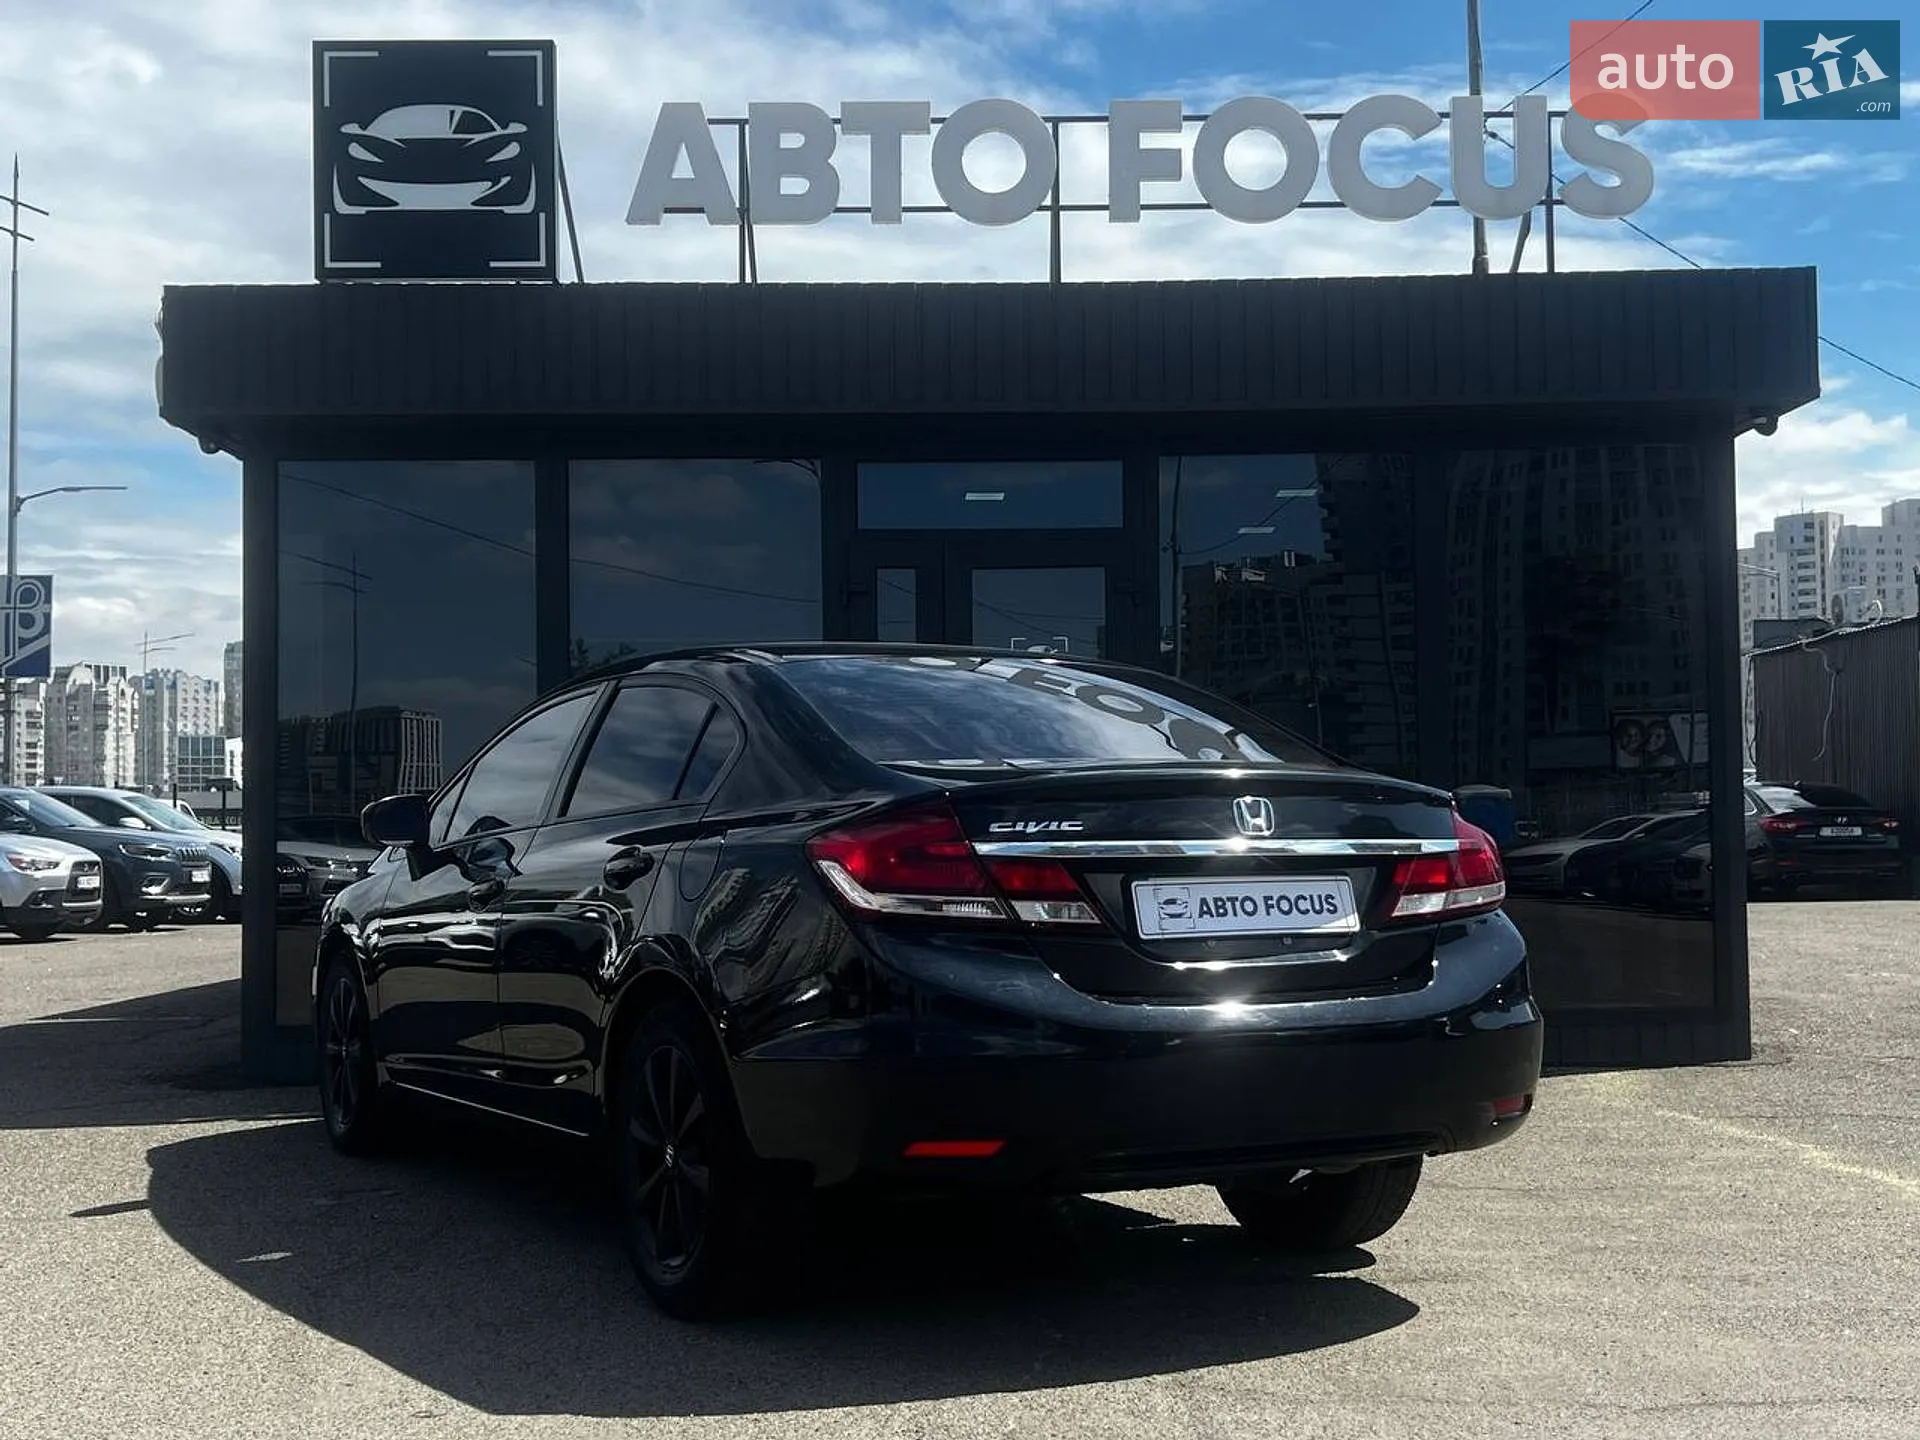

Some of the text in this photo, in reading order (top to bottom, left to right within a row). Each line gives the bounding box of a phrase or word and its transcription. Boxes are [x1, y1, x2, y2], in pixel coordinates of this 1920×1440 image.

[625, 94, 1655, 226] АВТО FOCUS
[988, 820, 1084, 834] CIVIC
[1198, 893, 1338, 919] АВТО FOCUS
